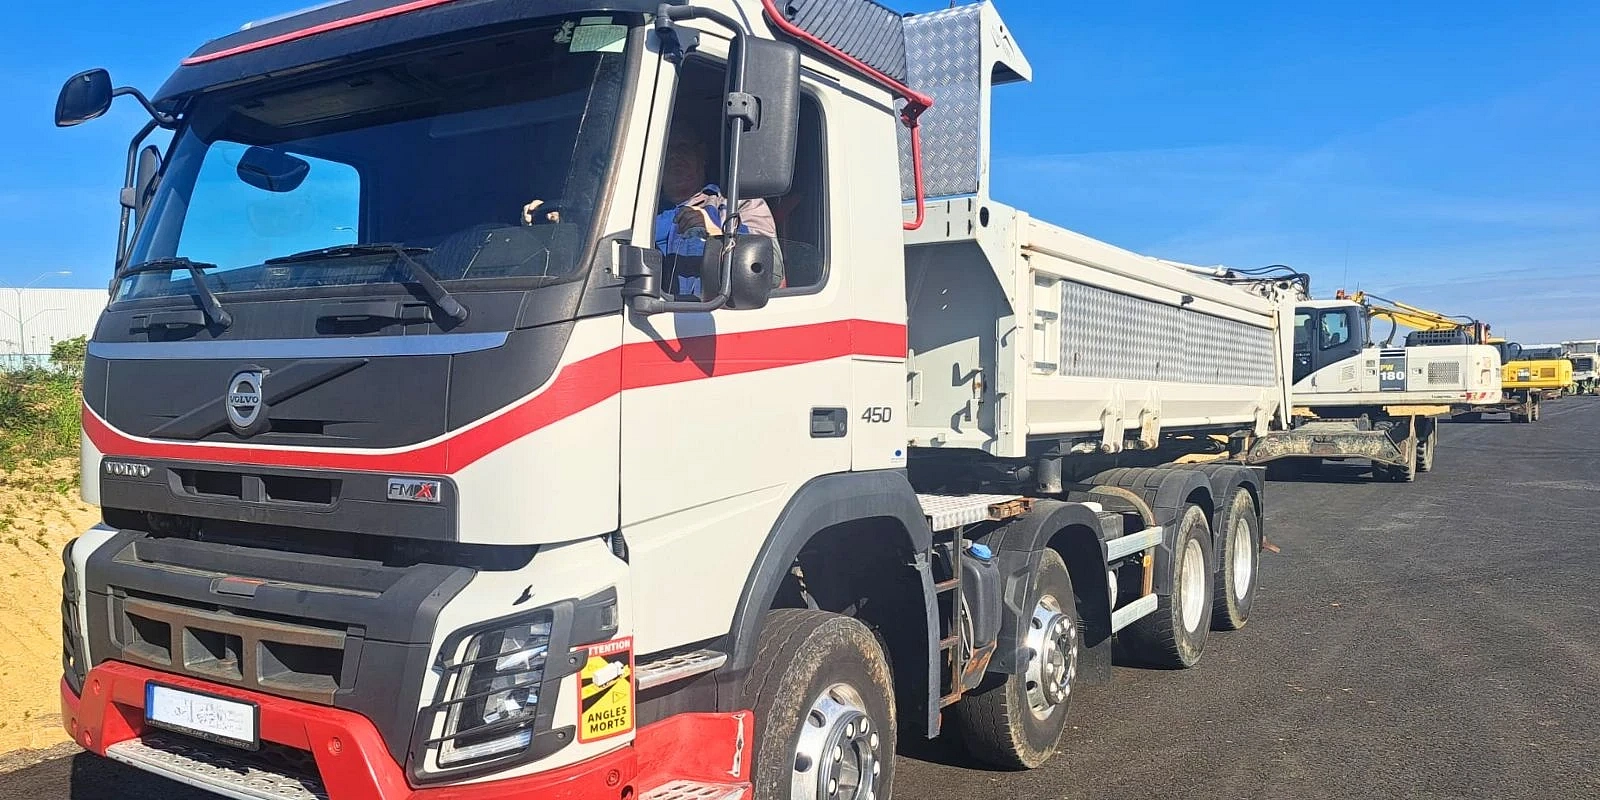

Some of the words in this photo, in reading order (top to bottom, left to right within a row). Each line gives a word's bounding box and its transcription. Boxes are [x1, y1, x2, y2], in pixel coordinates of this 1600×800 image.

[1380, 371, 1405, 380] 180
[230, 395, 259, 403] VOLVO
[861, 406, 892, 423] 450
[104, 461, 151, 477] VOLVO
[389, 481, 434, 501] FMX
[588, 640, 631, 657] TTENTION
[588, 706, 627, 723] ANGLES
[590, 717, 626, 733] MORTS
